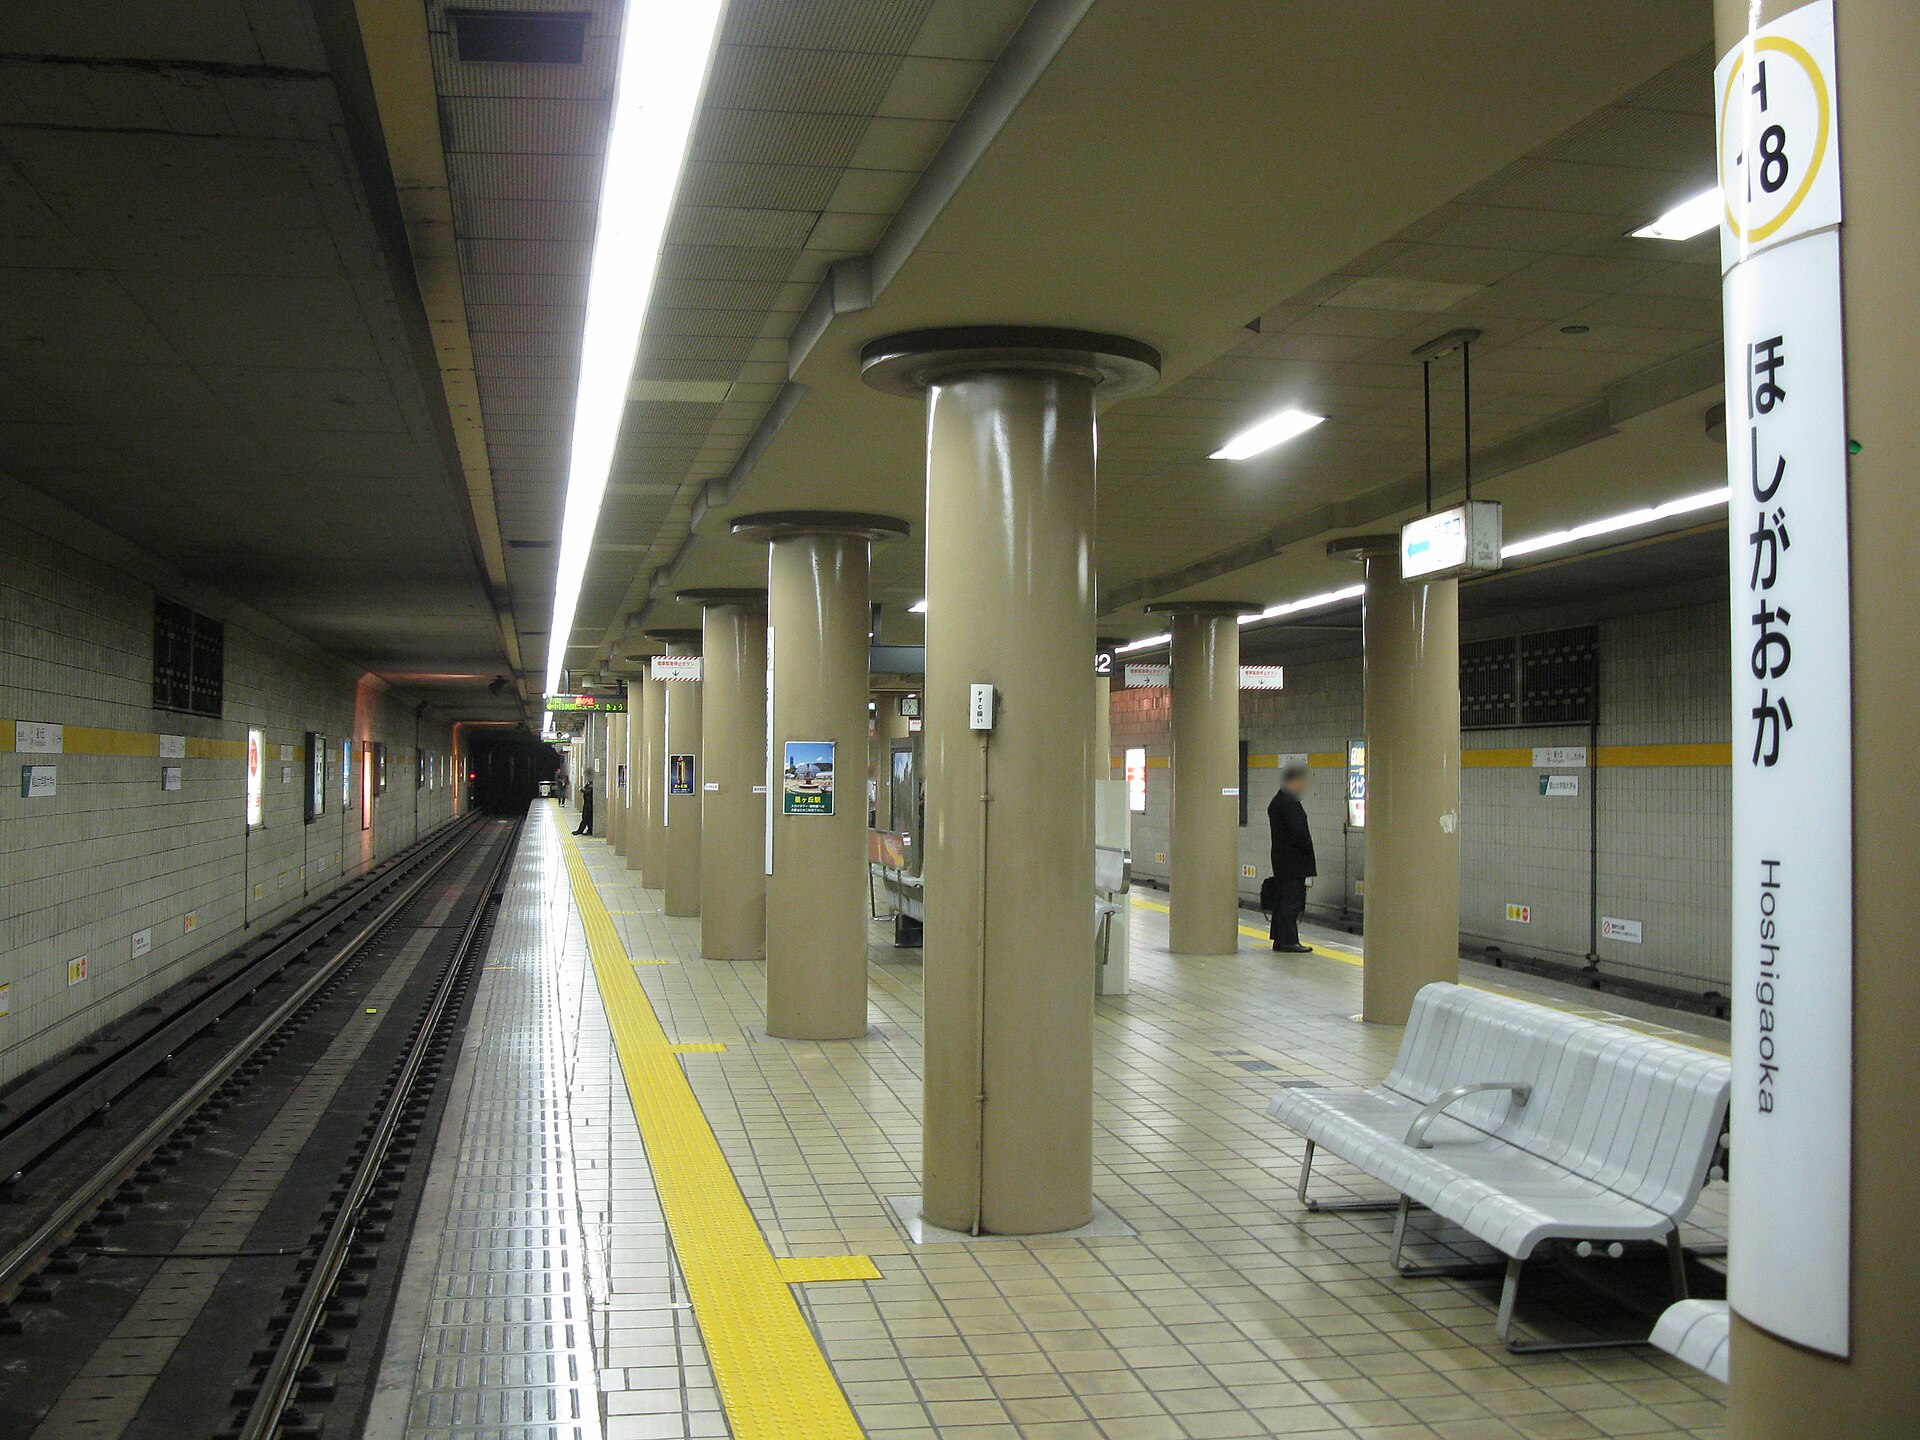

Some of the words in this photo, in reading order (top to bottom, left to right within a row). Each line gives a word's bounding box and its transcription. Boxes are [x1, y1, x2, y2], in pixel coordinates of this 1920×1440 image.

[1737, 124, 1789, 203] 8
[1747, 335, 1793, 768] ほしがおか
[605, 703, 624, 711] きょう
[1756, 860, 1781, 1114] Hoshigaoka
